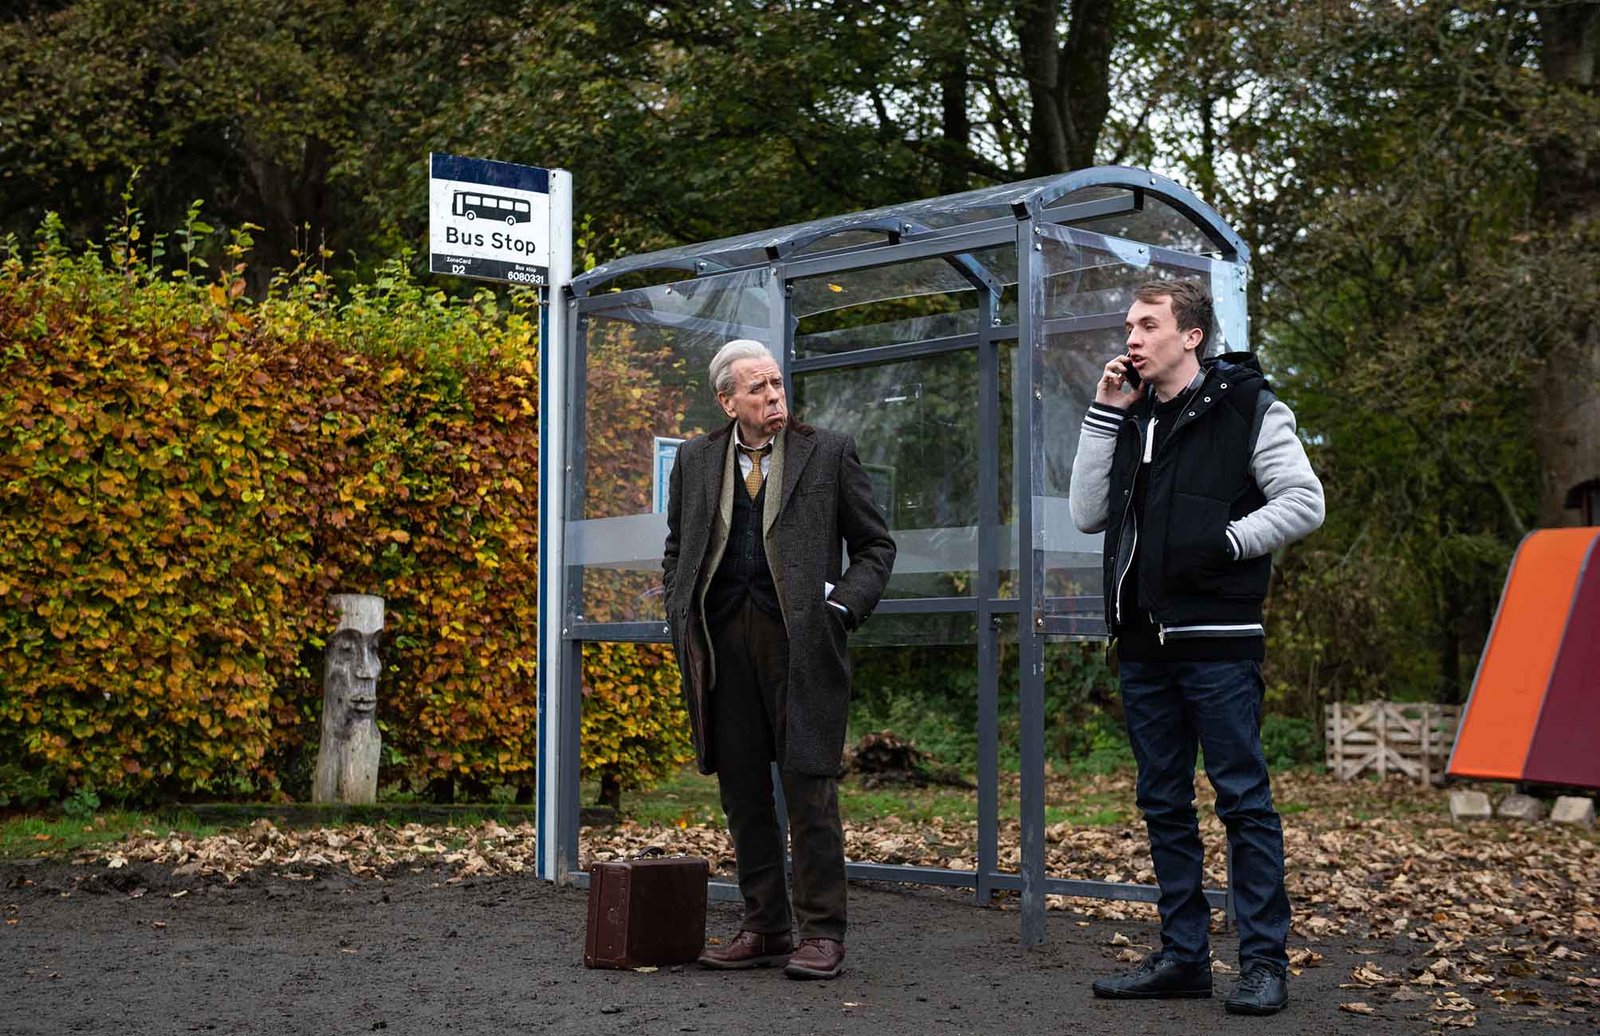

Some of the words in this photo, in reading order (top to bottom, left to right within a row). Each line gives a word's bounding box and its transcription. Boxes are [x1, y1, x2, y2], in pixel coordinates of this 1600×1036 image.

[446, 226, 484, 246] Bus
[491, 232, 536, 256] Stop
[452, 264, 466, 275] D2
[507, 270, 544, 284] 6080331
